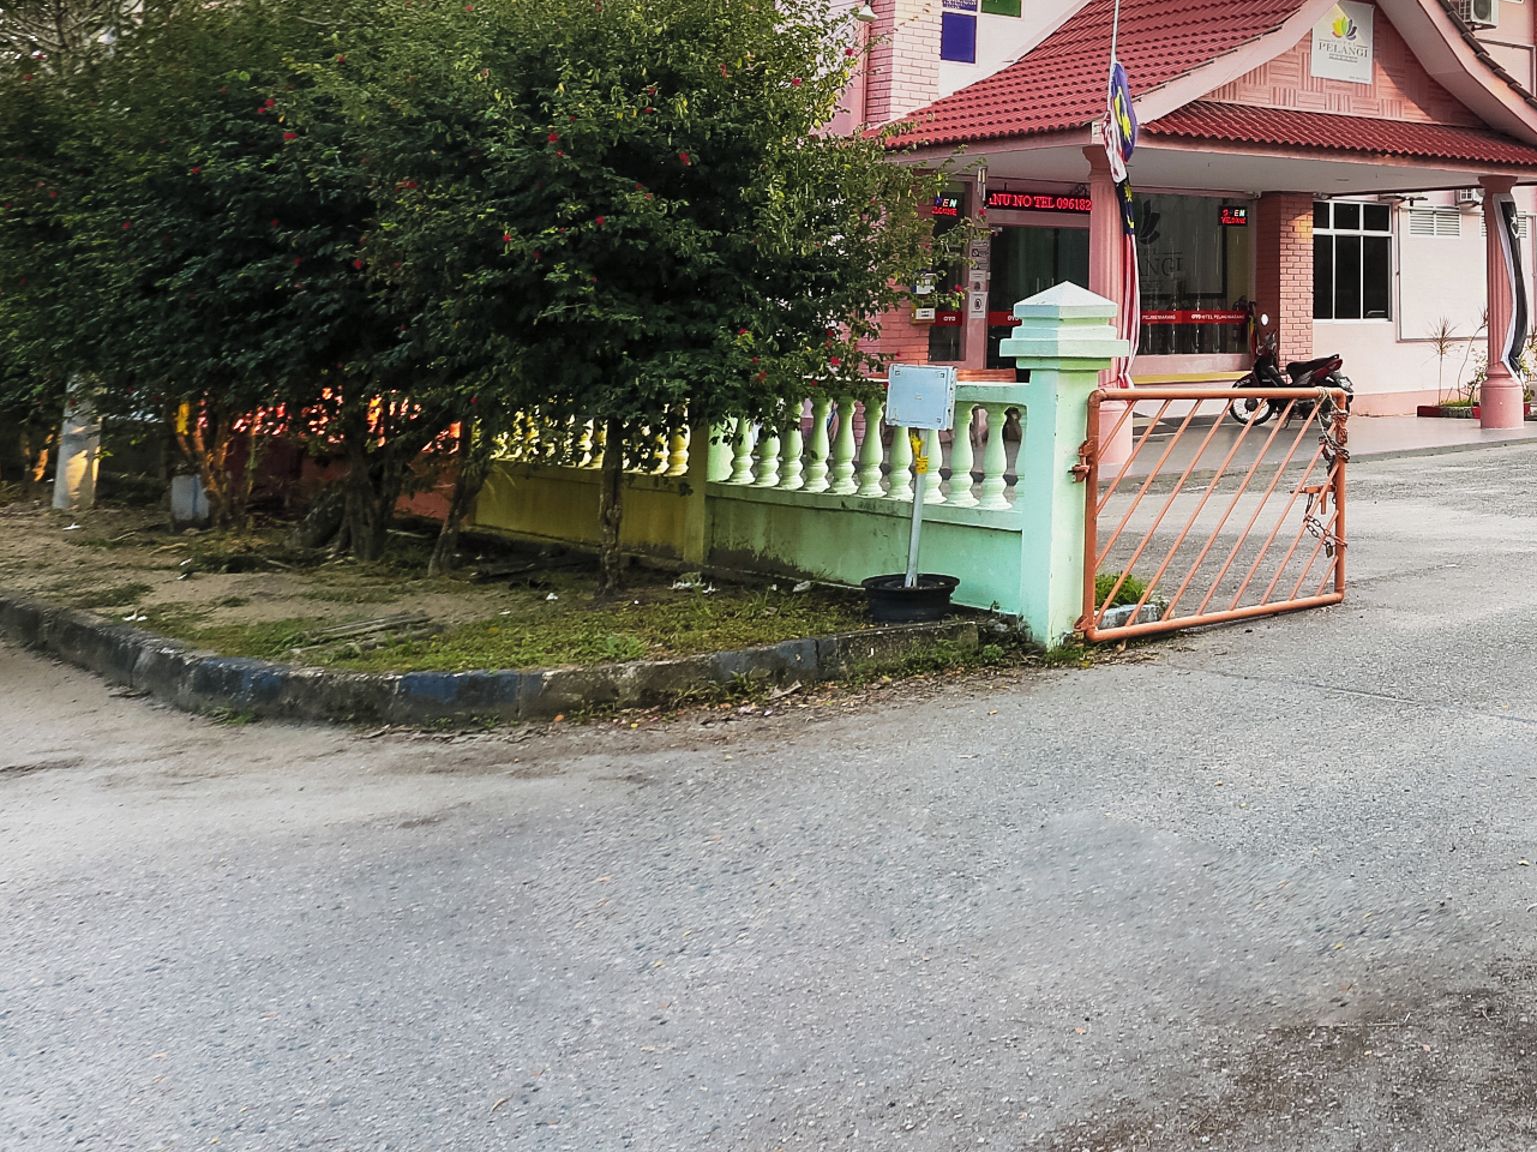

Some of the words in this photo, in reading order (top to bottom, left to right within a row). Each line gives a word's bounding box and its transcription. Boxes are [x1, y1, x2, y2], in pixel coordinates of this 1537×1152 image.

[1319, 41, 1368, 58] PELANGI
[1013, 195, 1032, 207] NO
[1033, 196, 1055, 208] TEL
